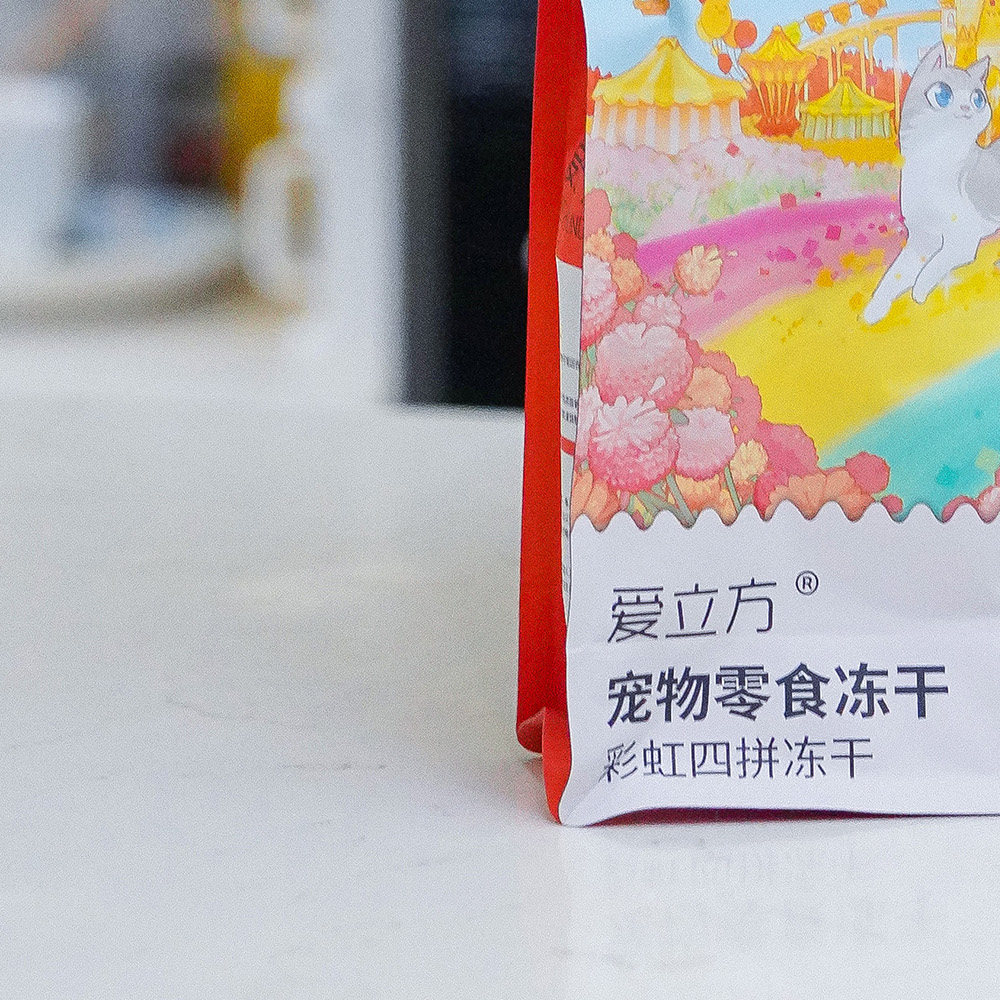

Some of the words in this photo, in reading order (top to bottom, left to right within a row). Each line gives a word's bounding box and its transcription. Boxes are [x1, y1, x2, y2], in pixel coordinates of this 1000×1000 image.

[607, 577, 778, 643] 爱立方
[607, 662, 949, 727] 宠物零食冻干
[602, 736, 873, 782] 彩虹四拼冻干
